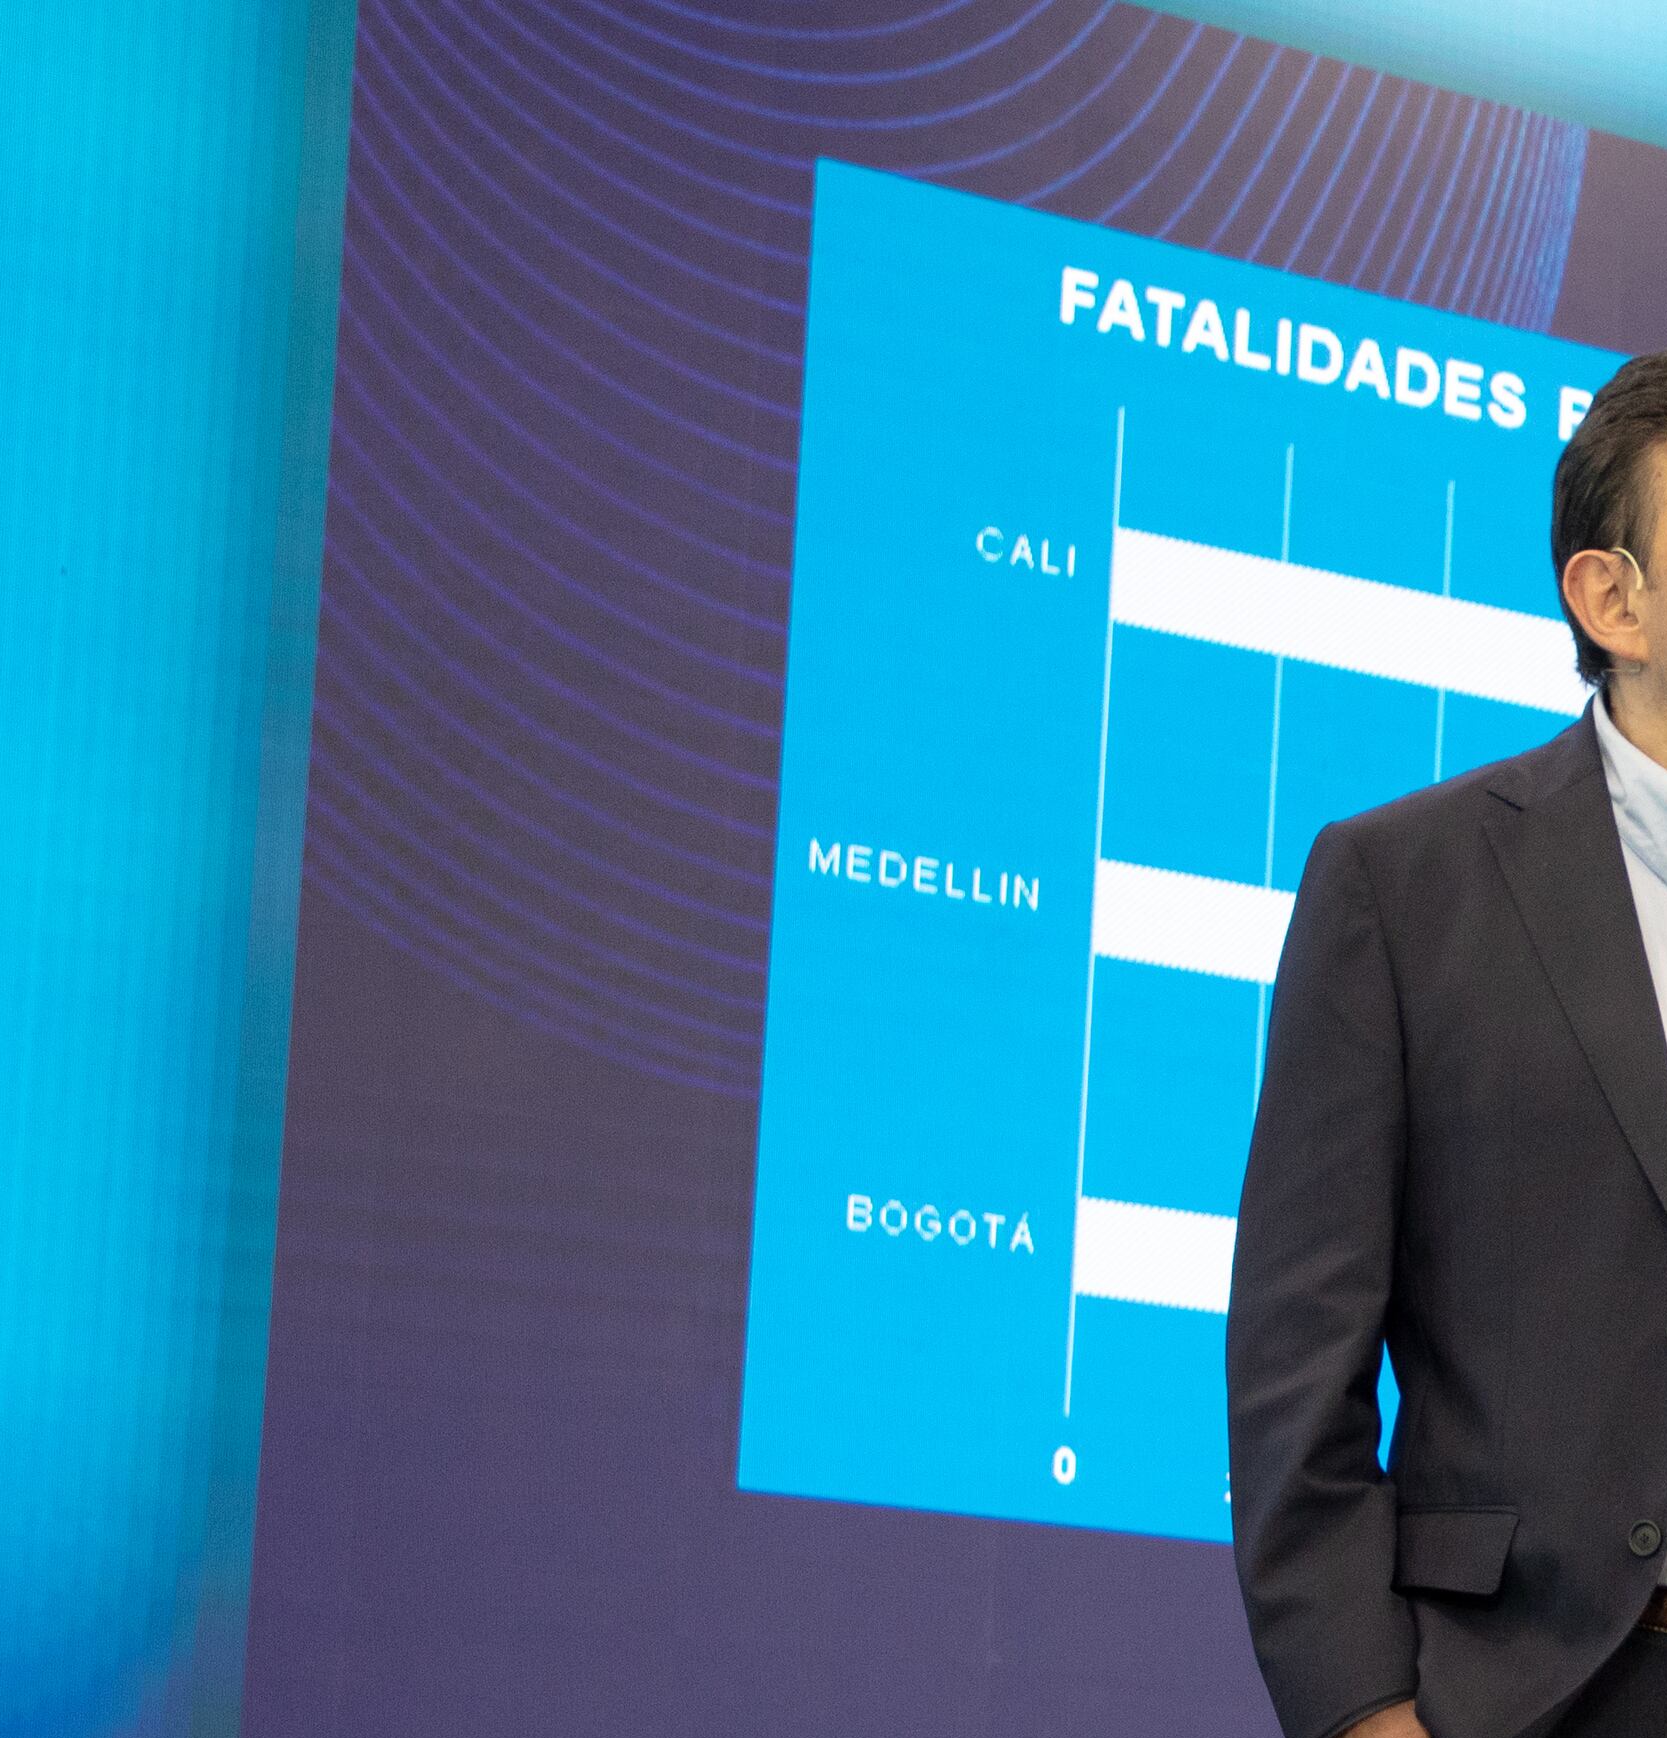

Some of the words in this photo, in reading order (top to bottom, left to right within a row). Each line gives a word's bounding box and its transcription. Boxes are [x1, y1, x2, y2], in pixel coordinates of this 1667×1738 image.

[1060, 266, 1527, 430] FATALIDADES
[976, 526, 1077, 578] CALI
[808, 838, 1040, 911] MEDELLIN
[846, 1194, 1035, 1254] BOGOTÁ
[1052, 1445, 1077, 1485] 0
